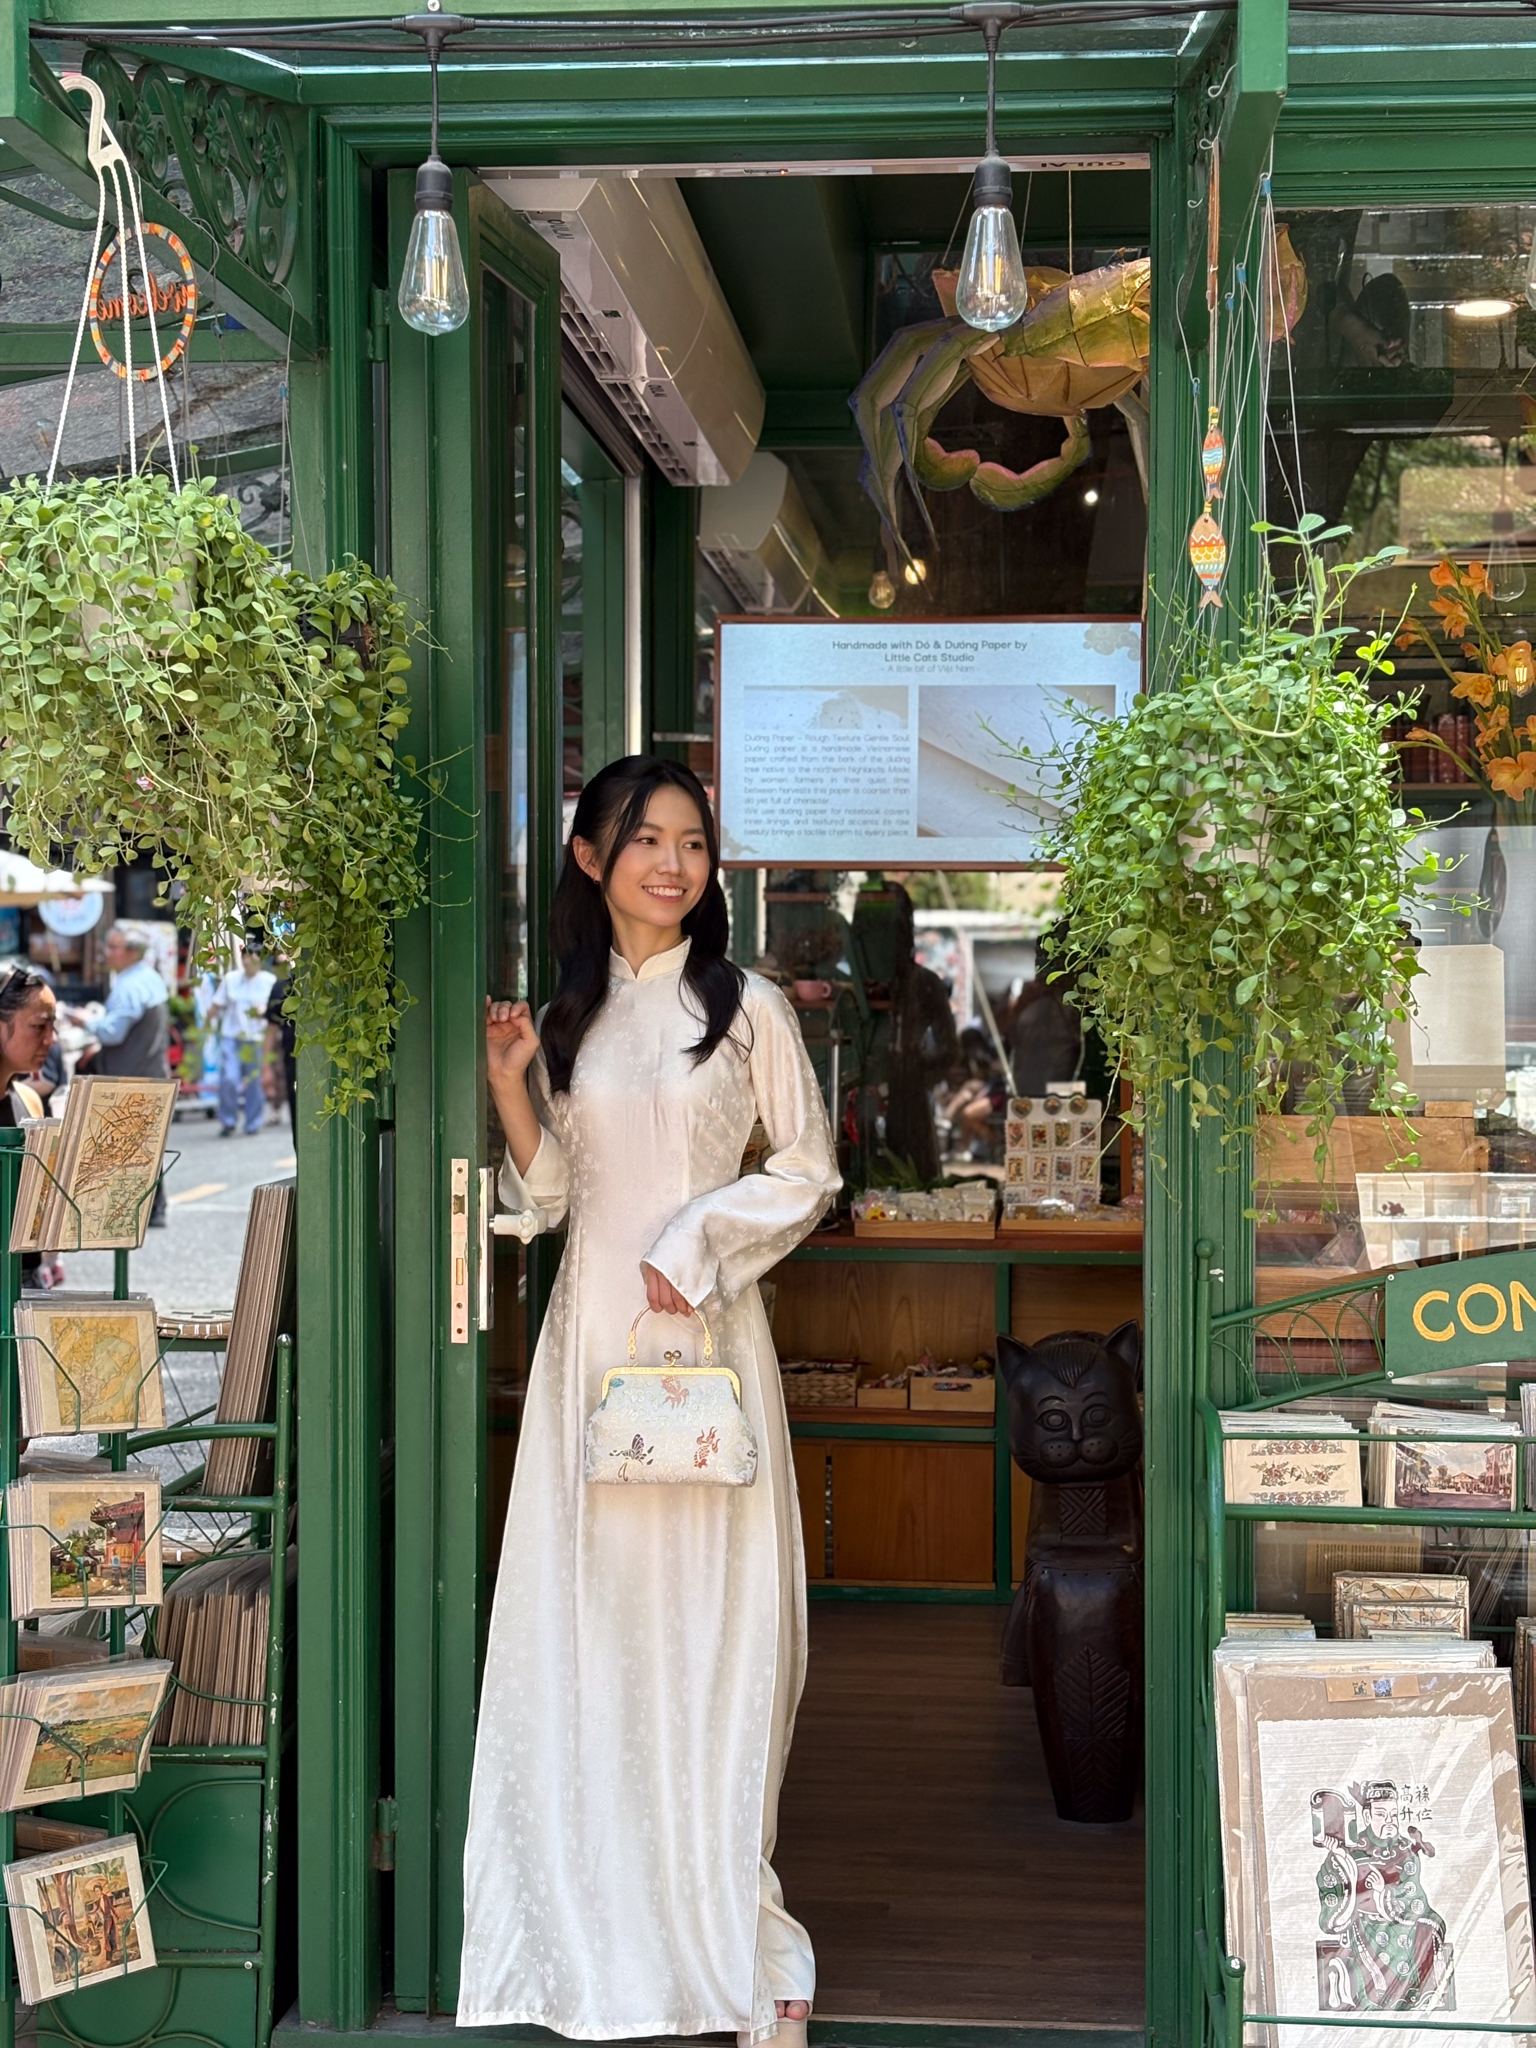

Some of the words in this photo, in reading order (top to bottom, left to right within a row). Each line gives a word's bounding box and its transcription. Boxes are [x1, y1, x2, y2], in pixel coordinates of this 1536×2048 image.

[833, 640, 887, 650] Handmade
[891, 640, 912, 650] with
[933, 640, 942, 650] &
[982, 640, 1011, 652] Paper
[1015, 640, 1027, 652] by
[885, 653, 910, 662] Little
[914, 653, 938, 662] Cats
[941, 653, 974, 662] Studio
[773, 733, 794, 744] Paper
[832, 733, 861, 742] Texture
[774, 746, 796, 754] paper
[821, 744, 861, 752] handmade
[866, 744, 910, 752] Vietnamese
[744, 756, 766, 765] paper
[770, 754, 797, 762] crafted
[801, 754, 819, 762] from
[822, 754, 835, 762] the
[870, 754, 882, 762] the
[744, 765, 760, 773] tree
[762, 765, 785, 773] native
[798, 765, 811, 773] the
[813, 765, 845, 773] northern
[744, 775, 753, 786] by
[844, 775, 860, 783] their
[744, 786, 777, 794] between
[813, 786, 827, 794] this
[829, 787, 851, 796] paper
[893, 786, 910, 794] than
[744, 806, 758, 815] We
[805, 808, 827, 817] paper
[831, 806, 841, 815] for
[845, 806, 880, 815] notebook
[794, 817, 808, 825] and
[812, 817, 844, 825] textured
[744, 827, 769, 838] beauty
[772, 827, 795, 838] brings
[829, 827, 853, 836] charm
